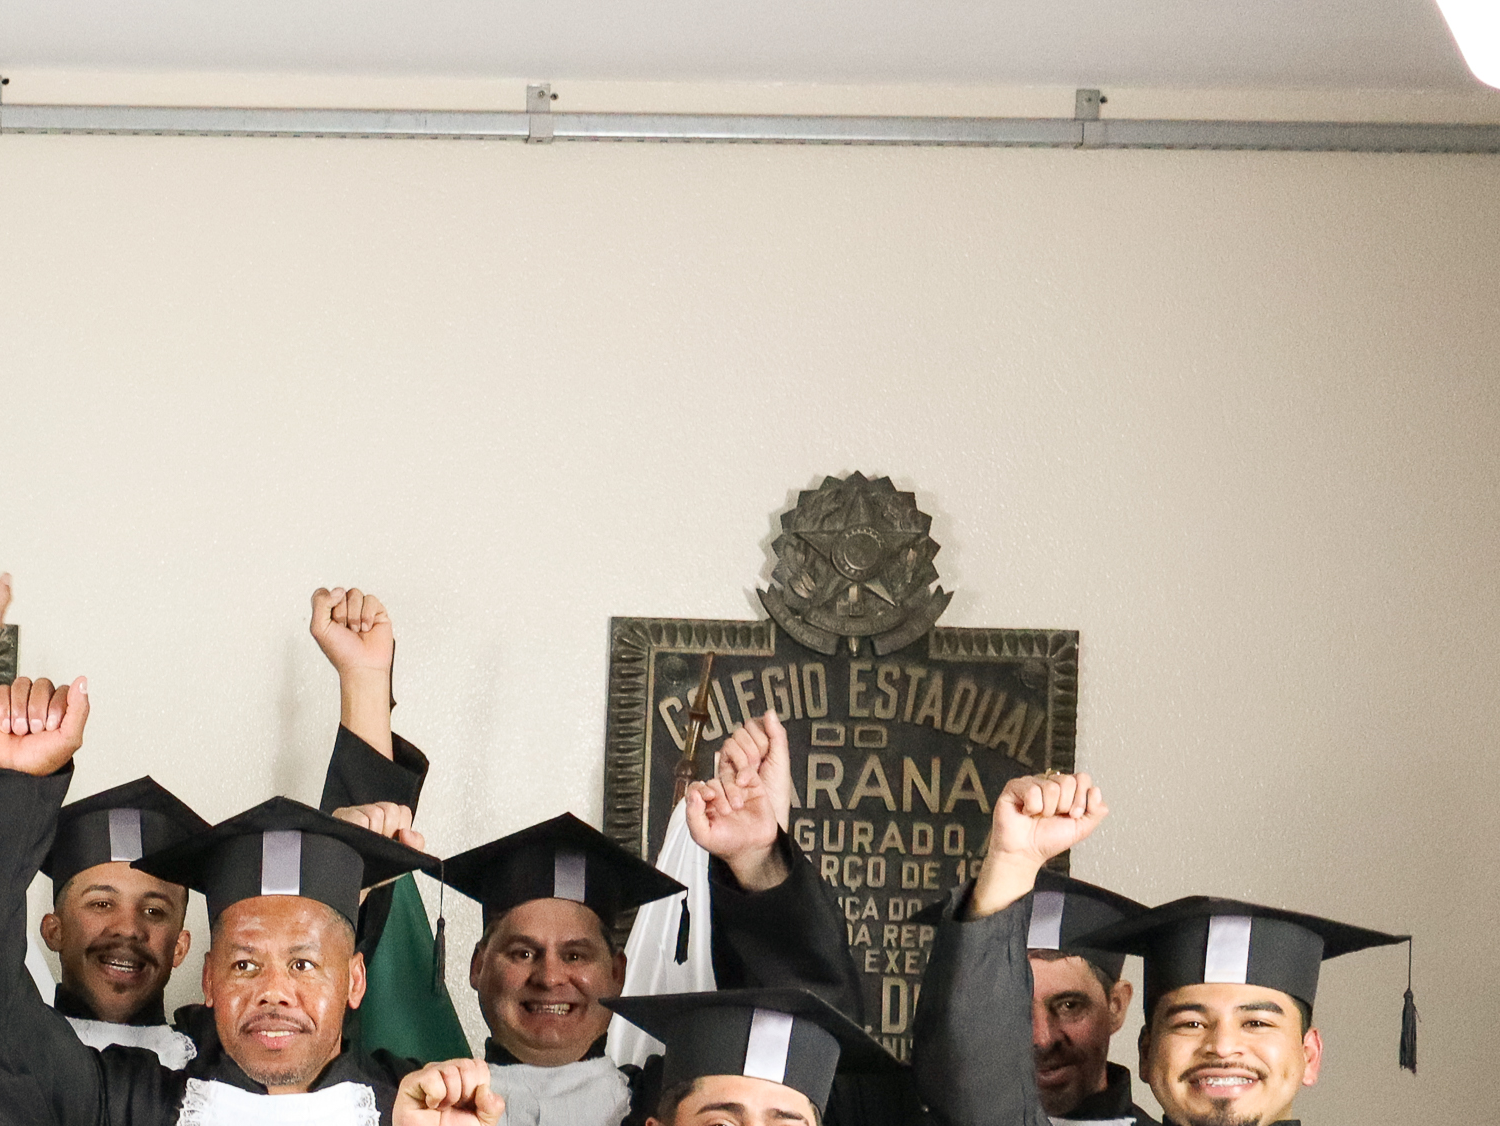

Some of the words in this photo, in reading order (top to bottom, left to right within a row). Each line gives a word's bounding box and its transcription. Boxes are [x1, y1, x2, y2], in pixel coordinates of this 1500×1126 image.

[848, 660, 1046, 768] ESTADUAL
[810, 721, 888, 749] DO
[901, 861, 941, 891] DE
